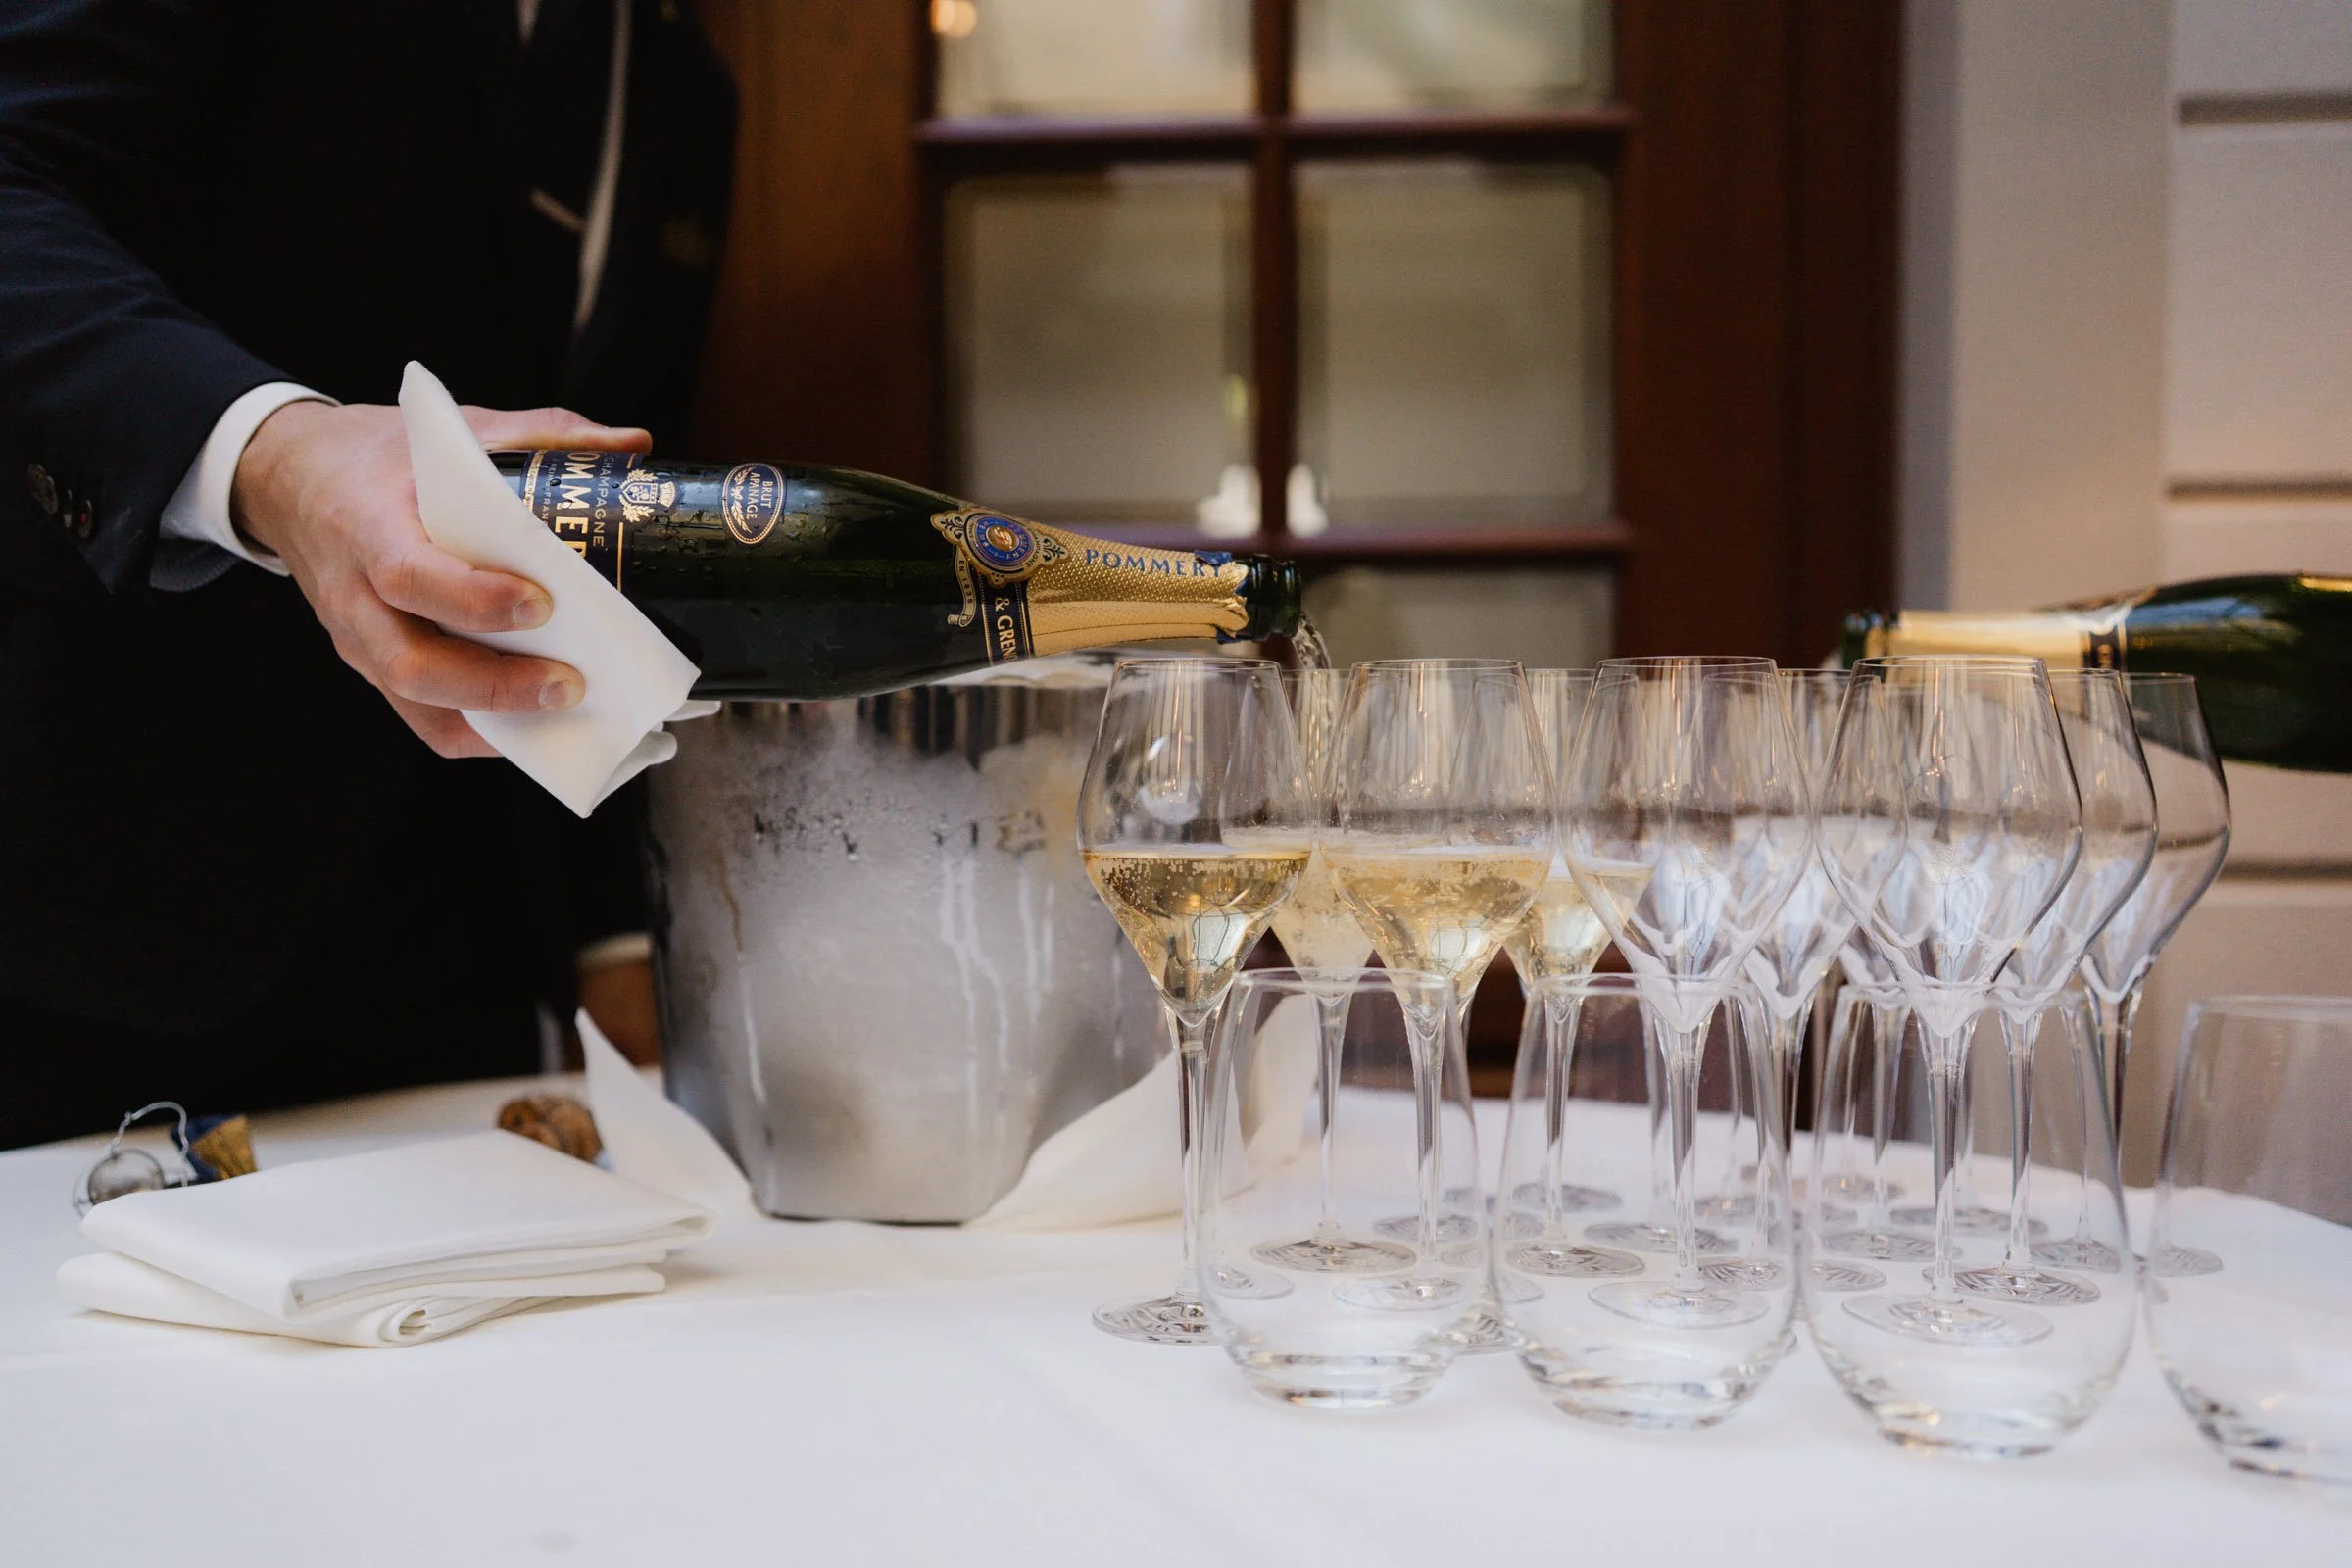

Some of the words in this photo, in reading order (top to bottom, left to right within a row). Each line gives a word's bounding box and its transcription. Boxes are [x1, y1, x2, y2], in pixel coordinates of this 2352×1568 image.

[541, 491, 551, 522] FRAN
[555, 452, 601, 558] OMME
[593, 457, 614, 547] CHAMPAGNE
[746, 472, 761, 519] APANAGE
[760, 480, 773, 509] BRUT
[958, 560, 966, 572] EN
[1085, 548, 1221, 577] POMMERY
[995, 597, 1010, 612] &
